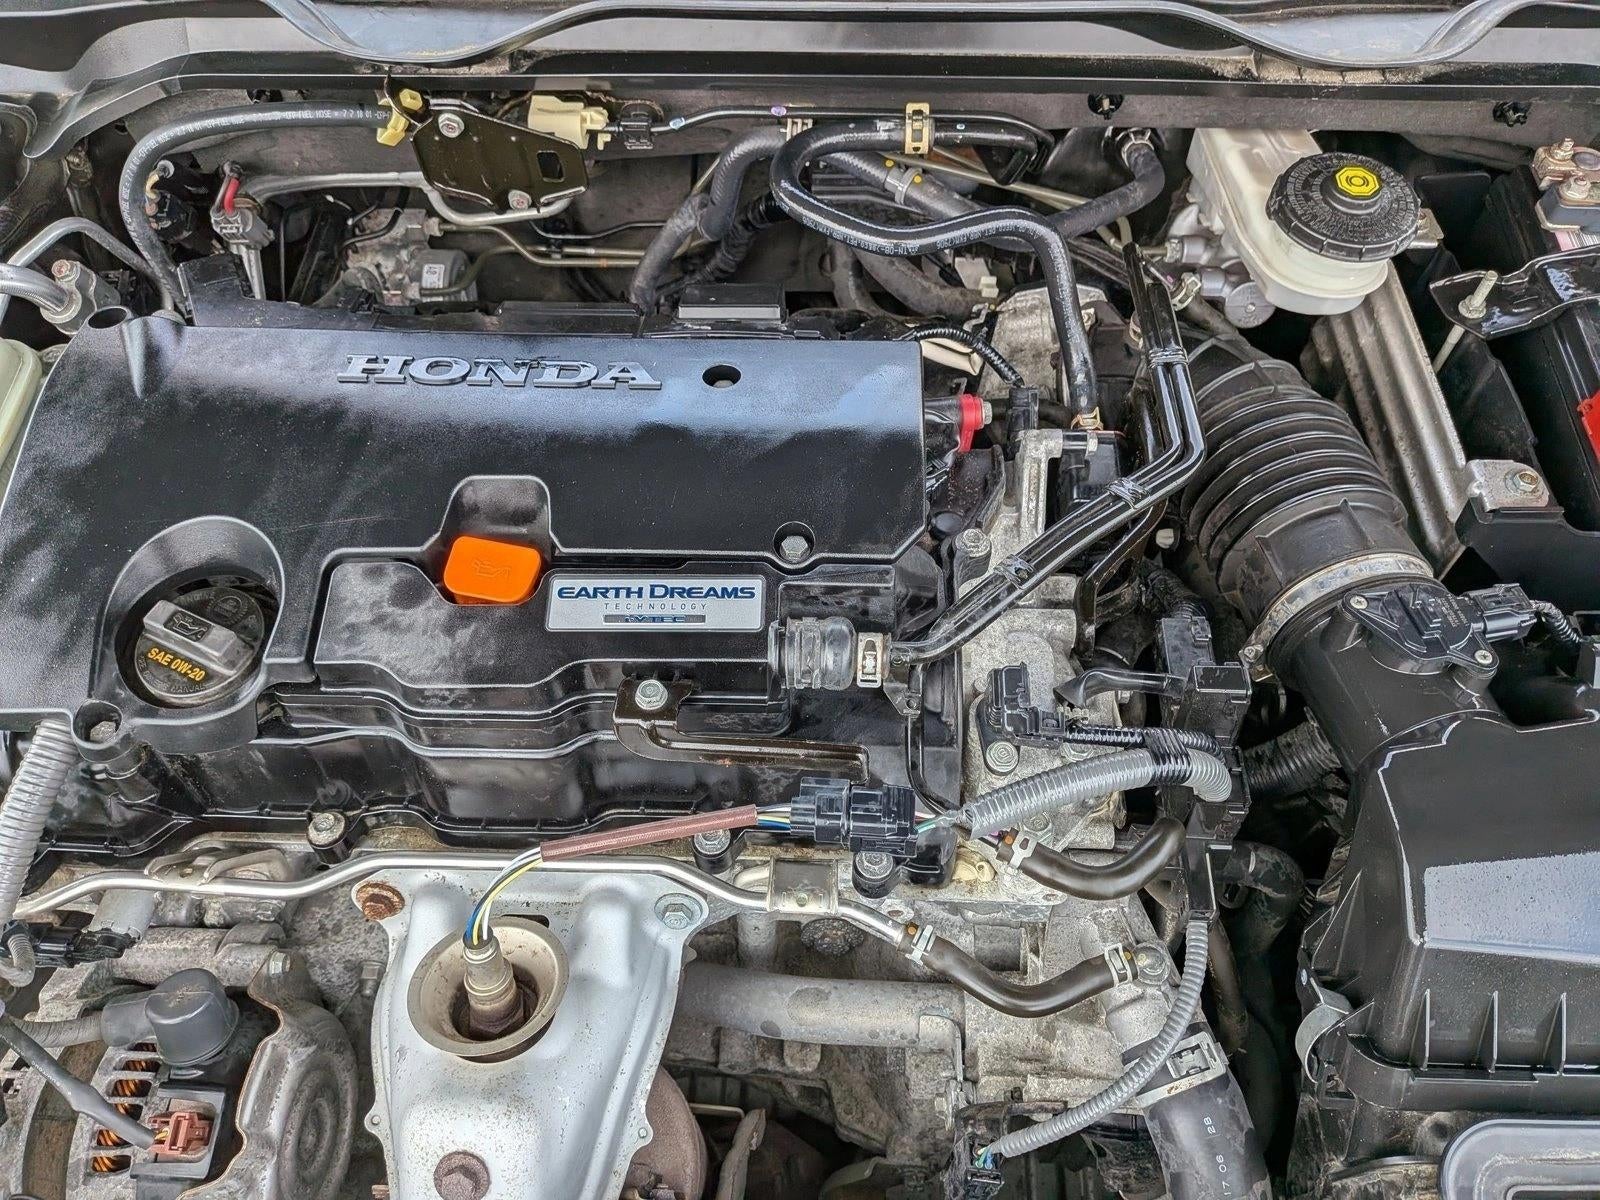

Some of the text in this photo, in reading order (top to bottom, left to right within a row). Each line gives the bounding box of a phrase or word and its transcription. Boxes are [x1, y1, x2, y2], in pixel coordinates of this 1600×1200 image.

[337, 354, 662, 389] HONDA
[557, 584, 756, 599] EARTH DREAMS
[604, 602, 708, 610] TECHNOLOGY
[147, 647, 206, 682] SAE 0W-20
[1203, 1116, 1216, 1134] 28
[1215, 1154, 1227, 1173] 06
